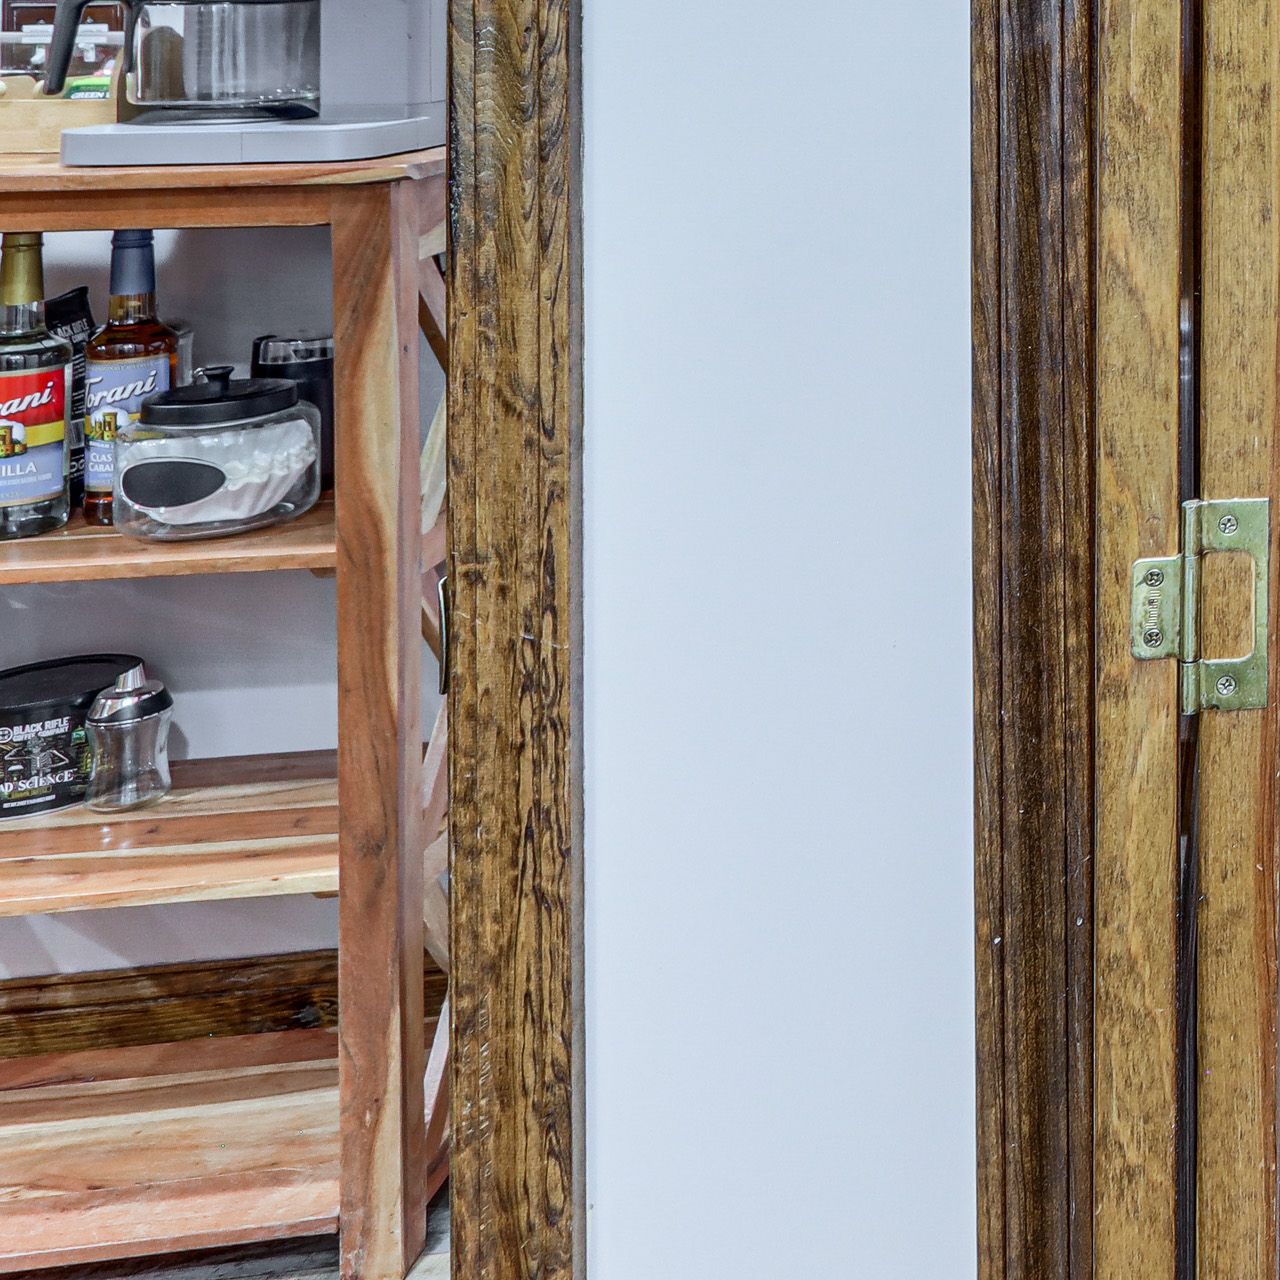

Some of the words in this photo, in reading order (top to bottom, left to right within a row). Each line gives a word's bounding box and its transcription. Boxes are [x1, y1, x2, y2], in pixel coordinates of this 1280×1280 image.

[0, 381, 54, 417] ani
[85, 370, 158, 408] Torani
[90, 452, 113, 463] CLAS
[1, 462, 38, 477] ILLA
[13, 721, 43, 735] BLACK
[45, 716, 71, 729] RIFLE
[18, 769, 75, 791] SCIENCE
